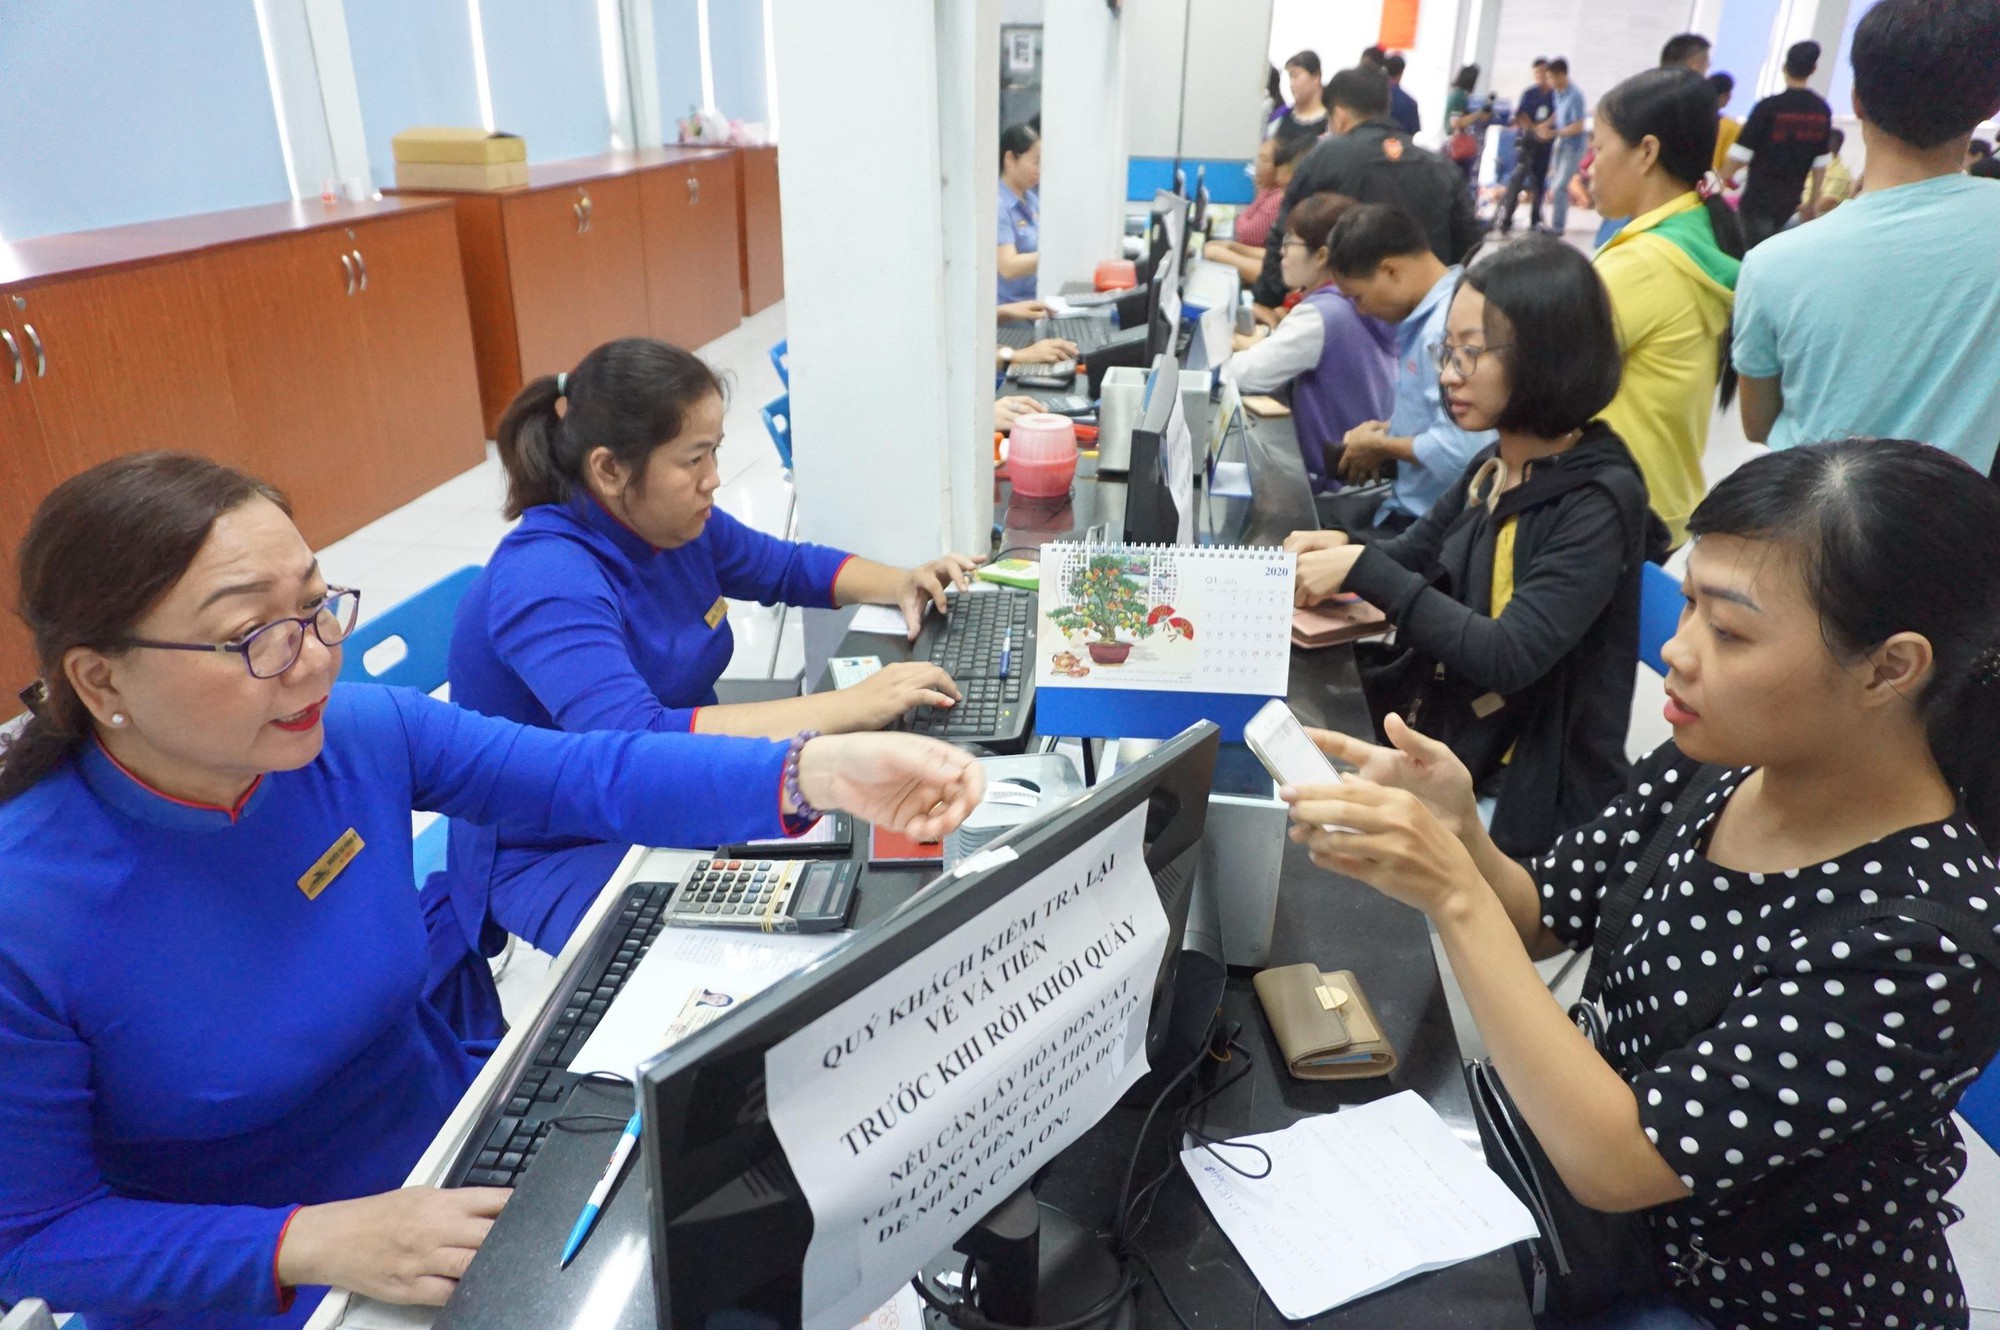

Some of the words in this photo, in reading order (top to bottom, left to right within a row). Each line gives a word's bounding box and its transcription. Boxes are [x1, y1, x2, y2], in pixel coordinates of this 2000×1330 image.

[1265, 567, 1289, 576] 2020
[822, 1012, 880, 1069] QUÝ
[888, 953, 974, 1026] KHÁCH
[1043, 883, 1080, 918] TRA
[1086, 853, 1115, 888] LẠI
[924, 995, 959, 1035] VÉ
[961, 971, 995, 1007] VÀ
[840, 1072, 937, 1156] TRƯỚC
[935, 1036, 985, 1085] KHI
[984, 1002, 1027, 1048] RỜI
[1028, 958, 1085, 1013] KHỎI
[862, 1195, 903, 1225] VUI
[910, 1146, 964, 1201] LÒNG
[968, 1099, 1019, 1149] CUNG
[1060, 1015, 1114, 1070] THÔNG
[1119, 990, 1140, 1020] TIN
[889, 1142, 931, 1189] NẾU
[1022, 1040, 1058, 1079] HÓA
[1101, 977, 1130, 1010] VAT
[916, 1165, 969, 1221] NHÂN
[975, 1125, 1016, 1167] VIÊN
[1021, 1093, 1054, 1129] TẠO
[1058, 1062, 1091, 1097] HÓA
[948, 1181, 985, 1223] XIN
